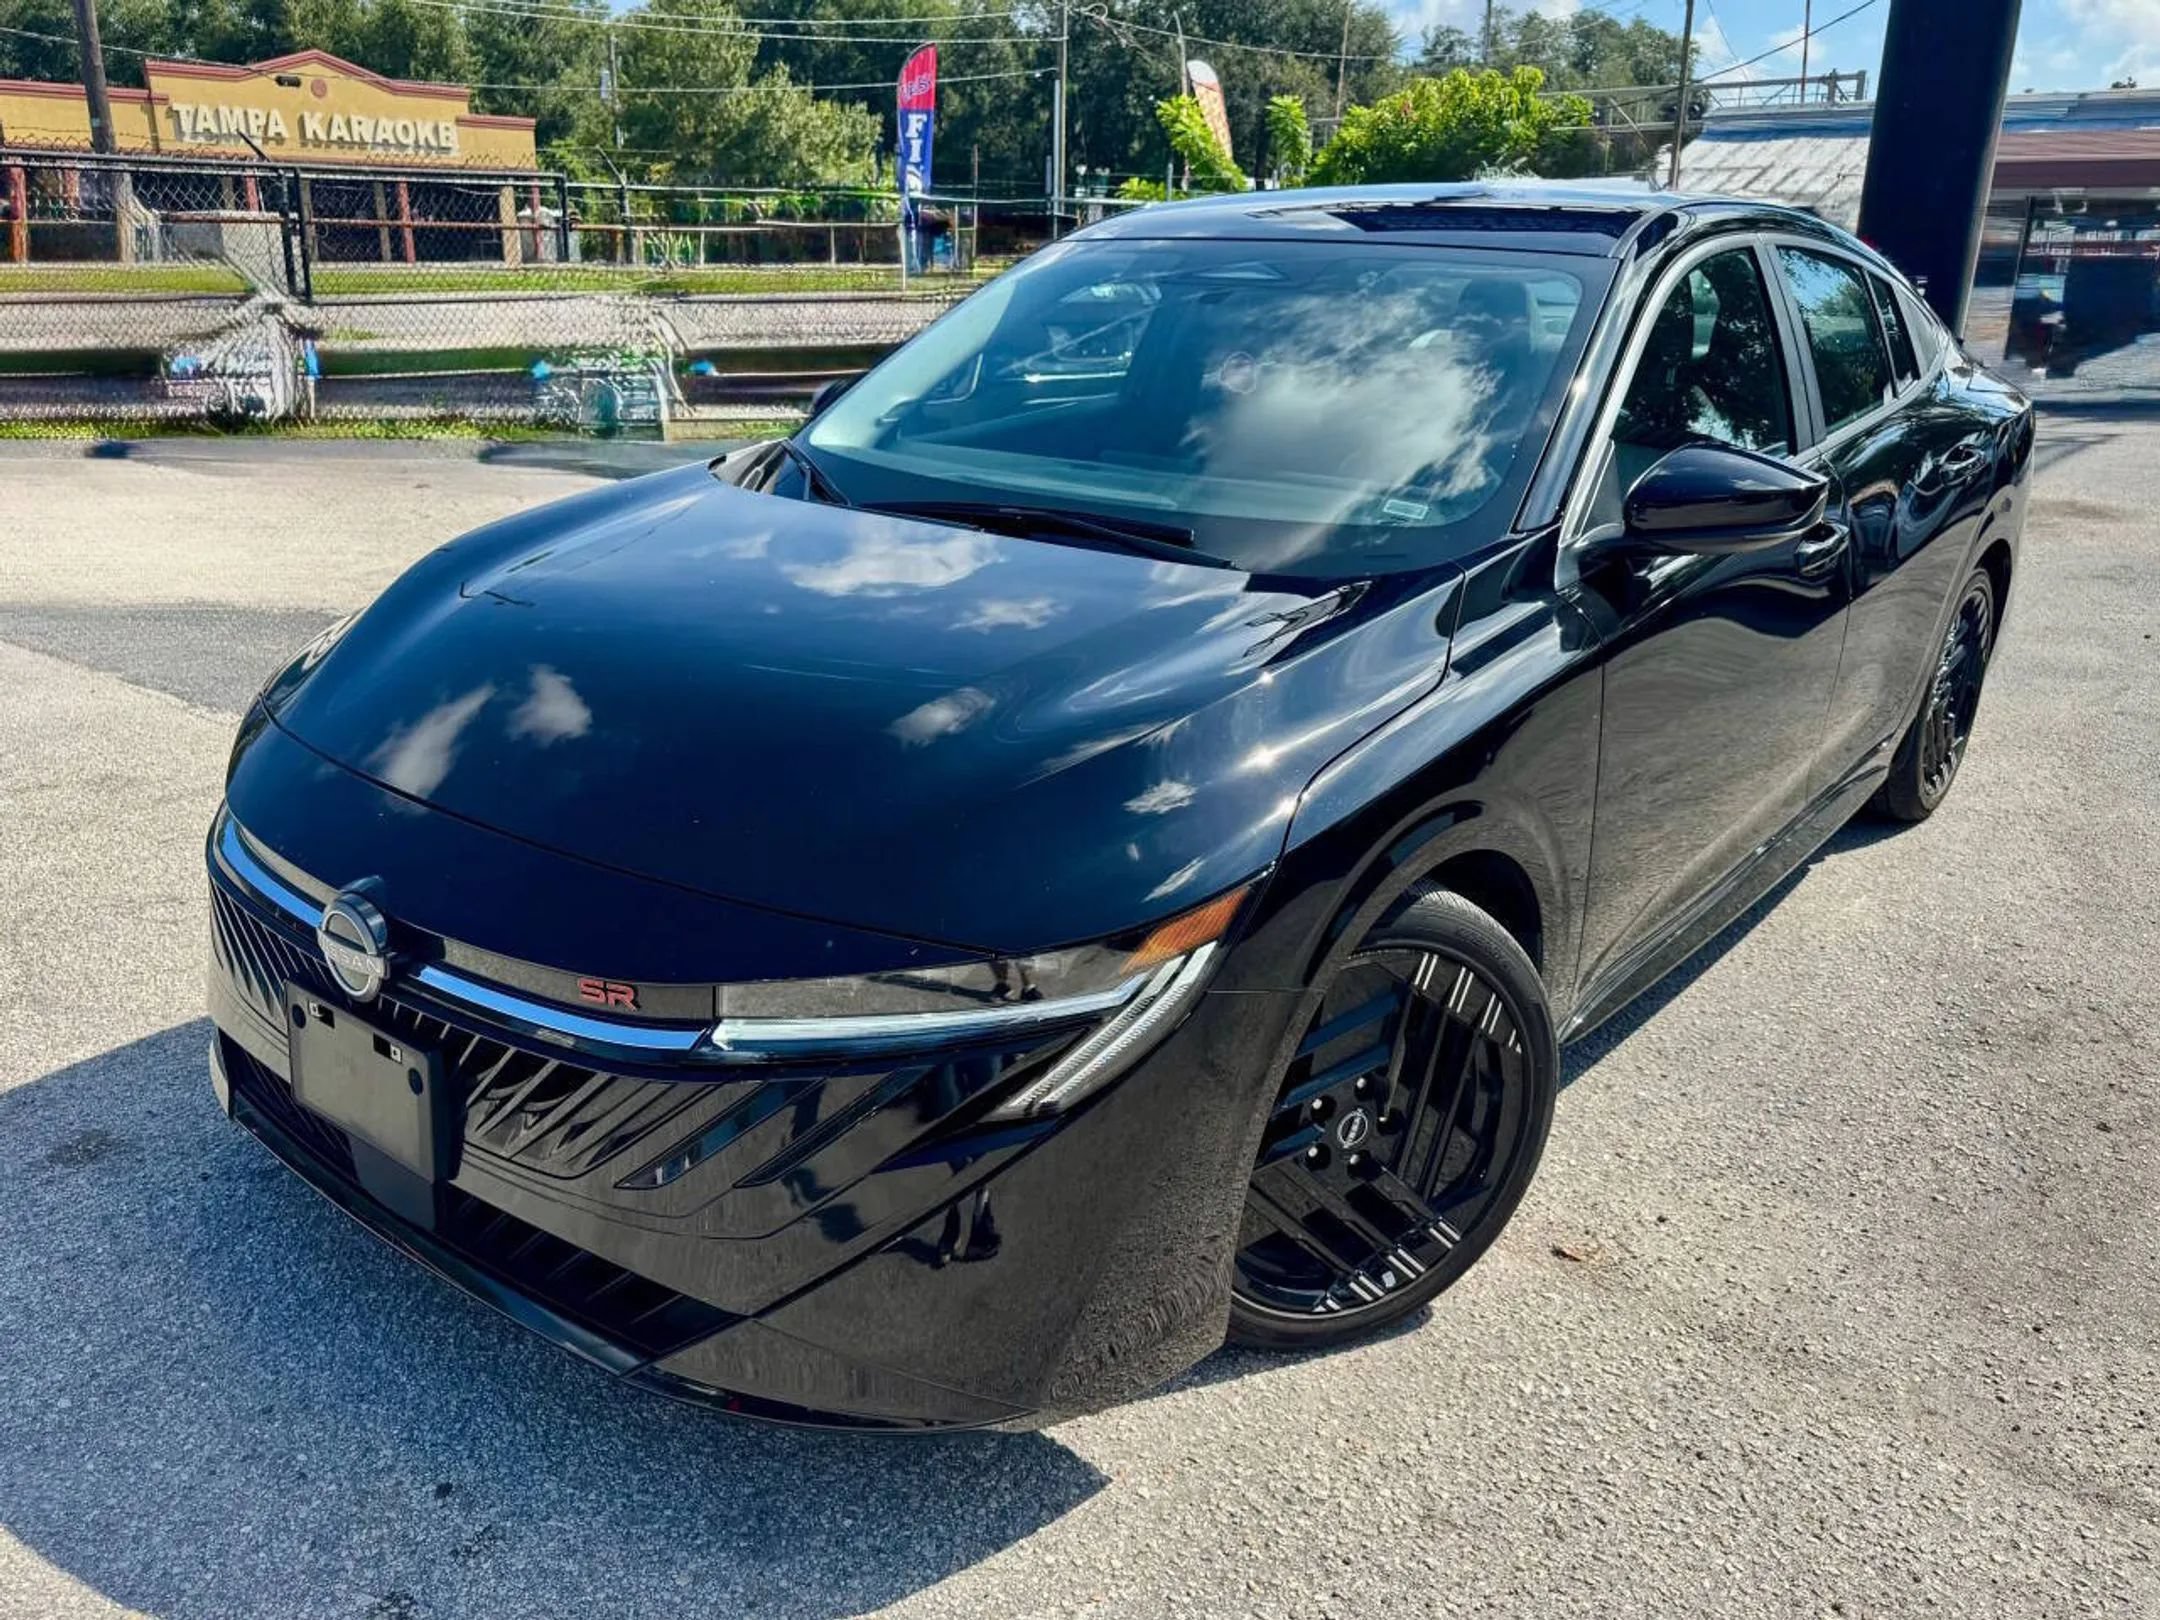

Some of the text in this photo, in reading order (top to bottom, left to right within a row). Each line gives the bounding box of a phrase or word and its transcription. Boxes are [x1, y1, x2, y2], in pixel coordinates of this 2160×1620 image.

[172, 103, 459, 151] TAMPA KARAOKE
[577, 977, 637, 1012] SR
